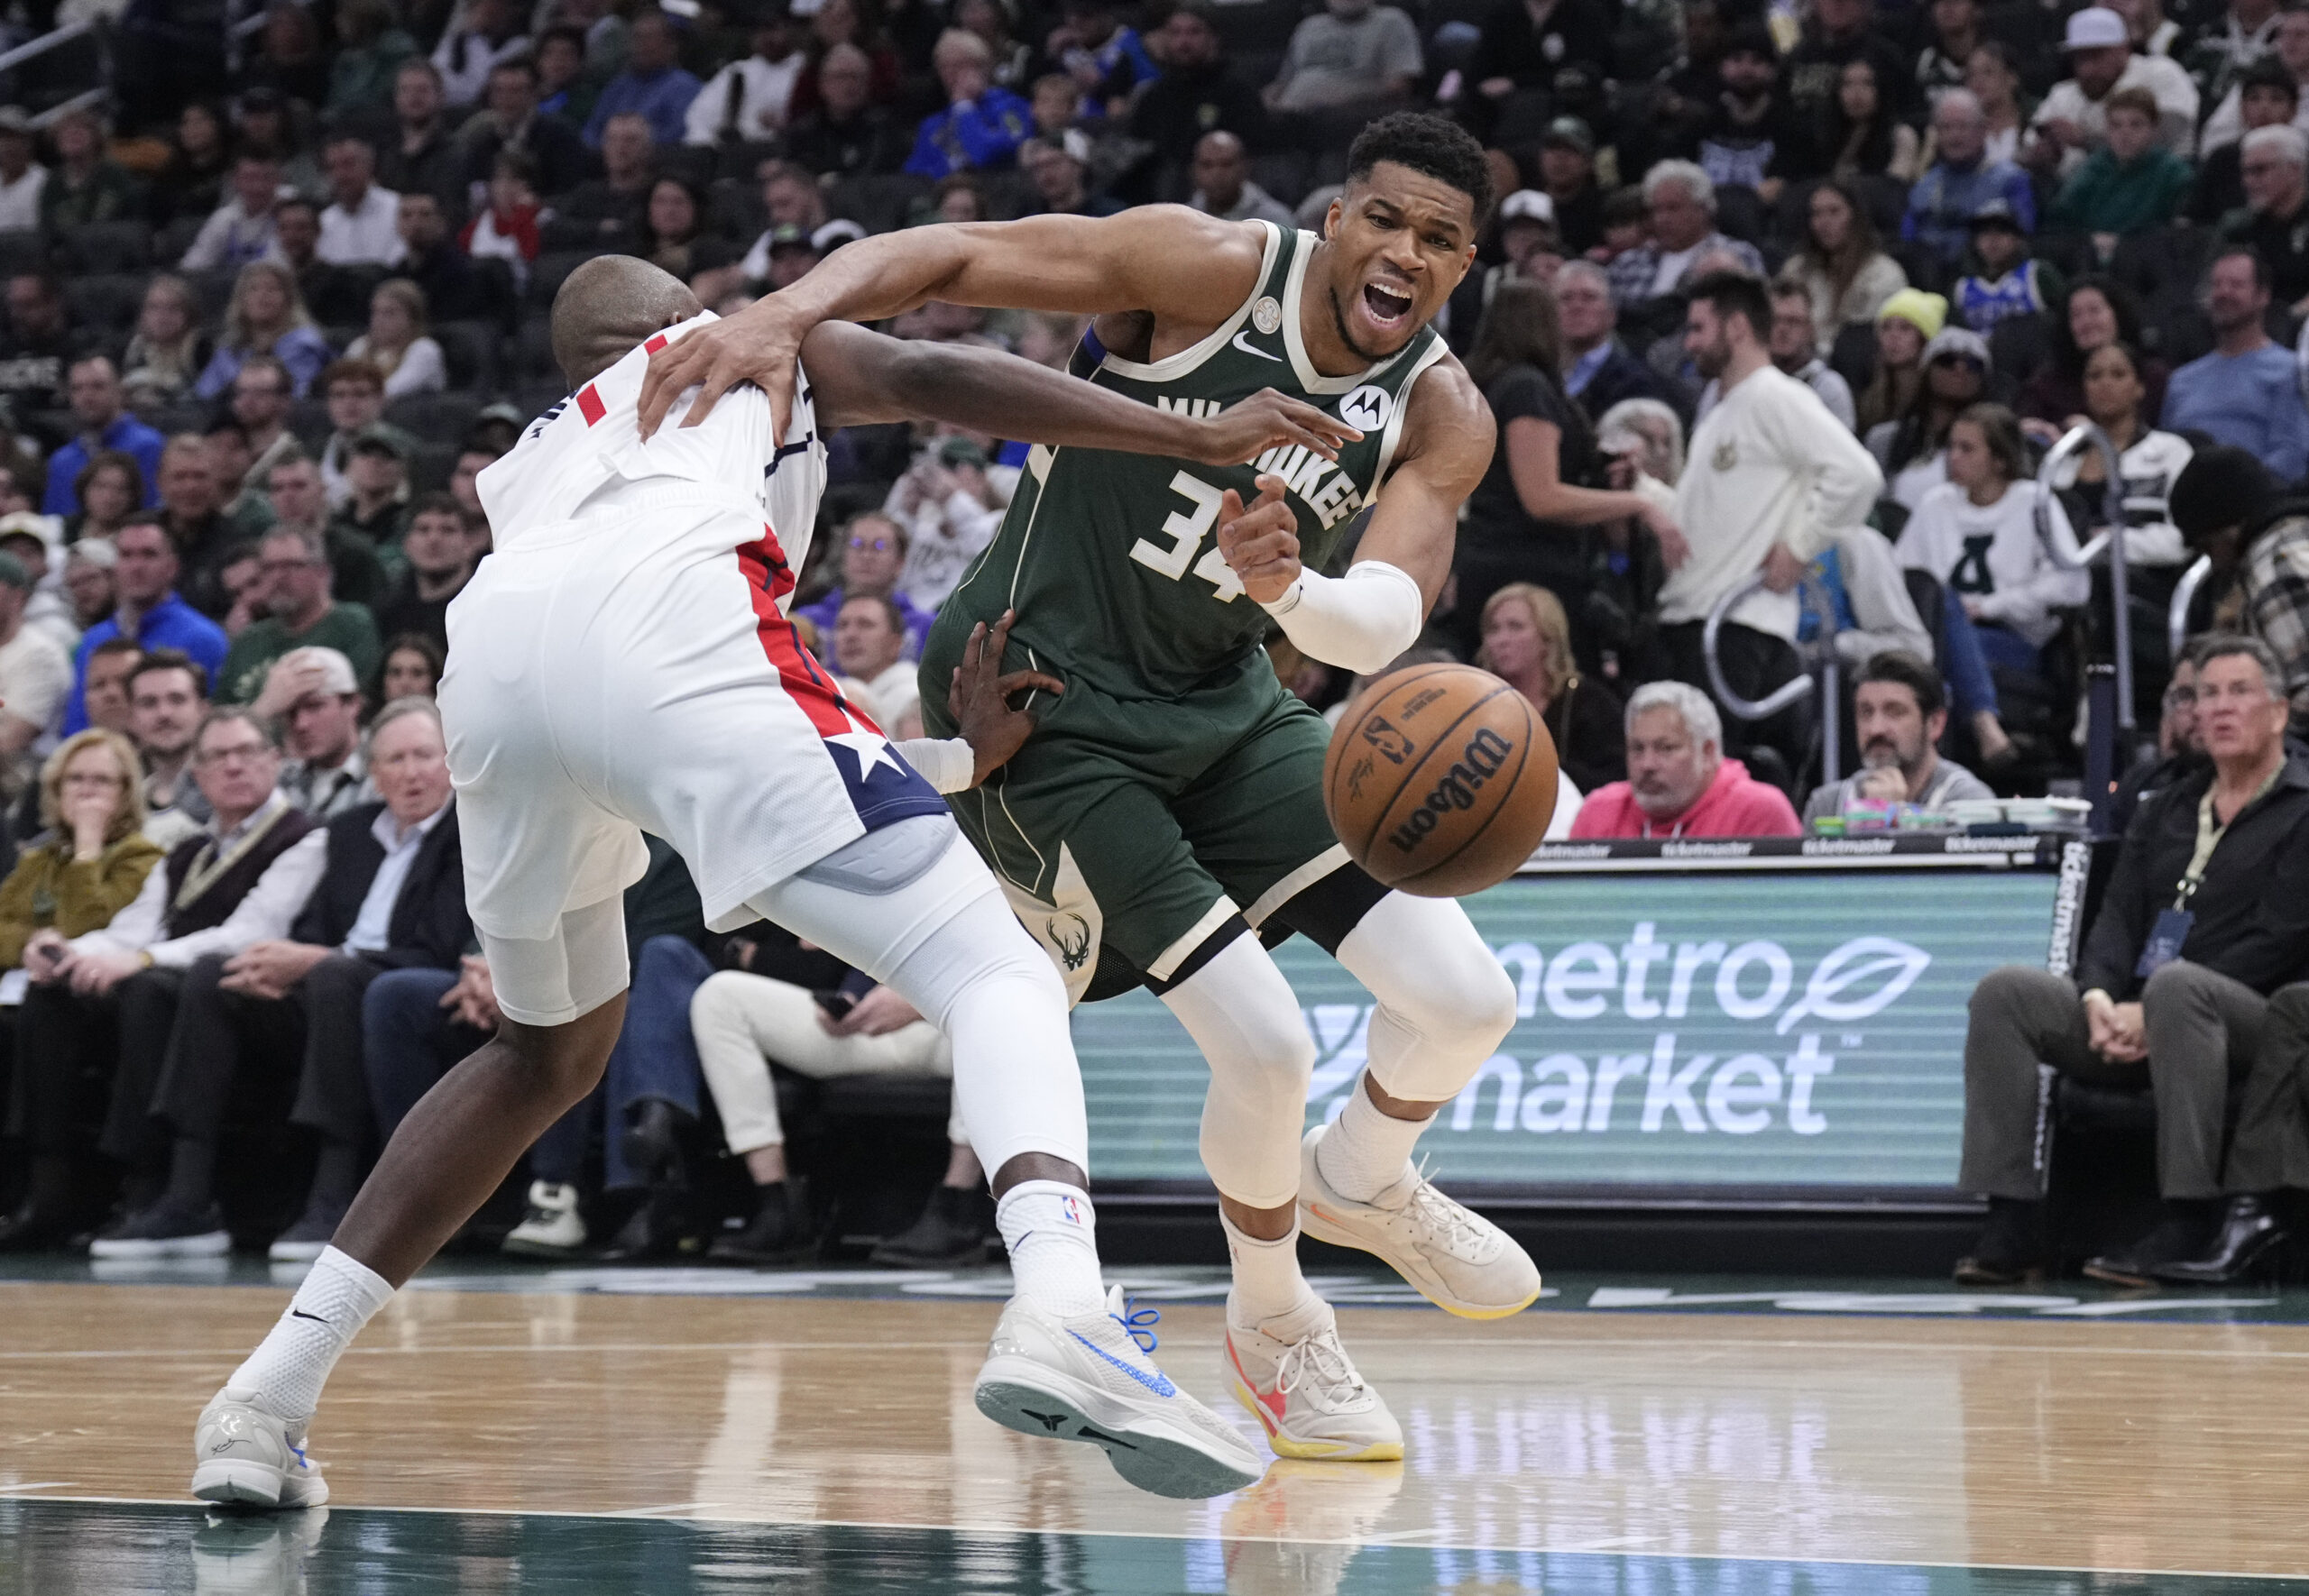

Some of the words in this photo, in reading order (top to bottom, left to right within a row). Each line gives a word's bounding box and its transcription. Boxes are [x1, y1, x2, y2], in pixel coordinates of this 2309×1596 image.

[1389, 727, 1513, 854] Wilson
[1532, 842, 1612, 858] ketmaster
[1660, 840, 1753, 858] ticketmaster
[1802, 838, 1896, 856] ticketmaster
[1945, 835, 2040, 853] ticketmaster
[2047, 840, 2089, 977] ticketmast
